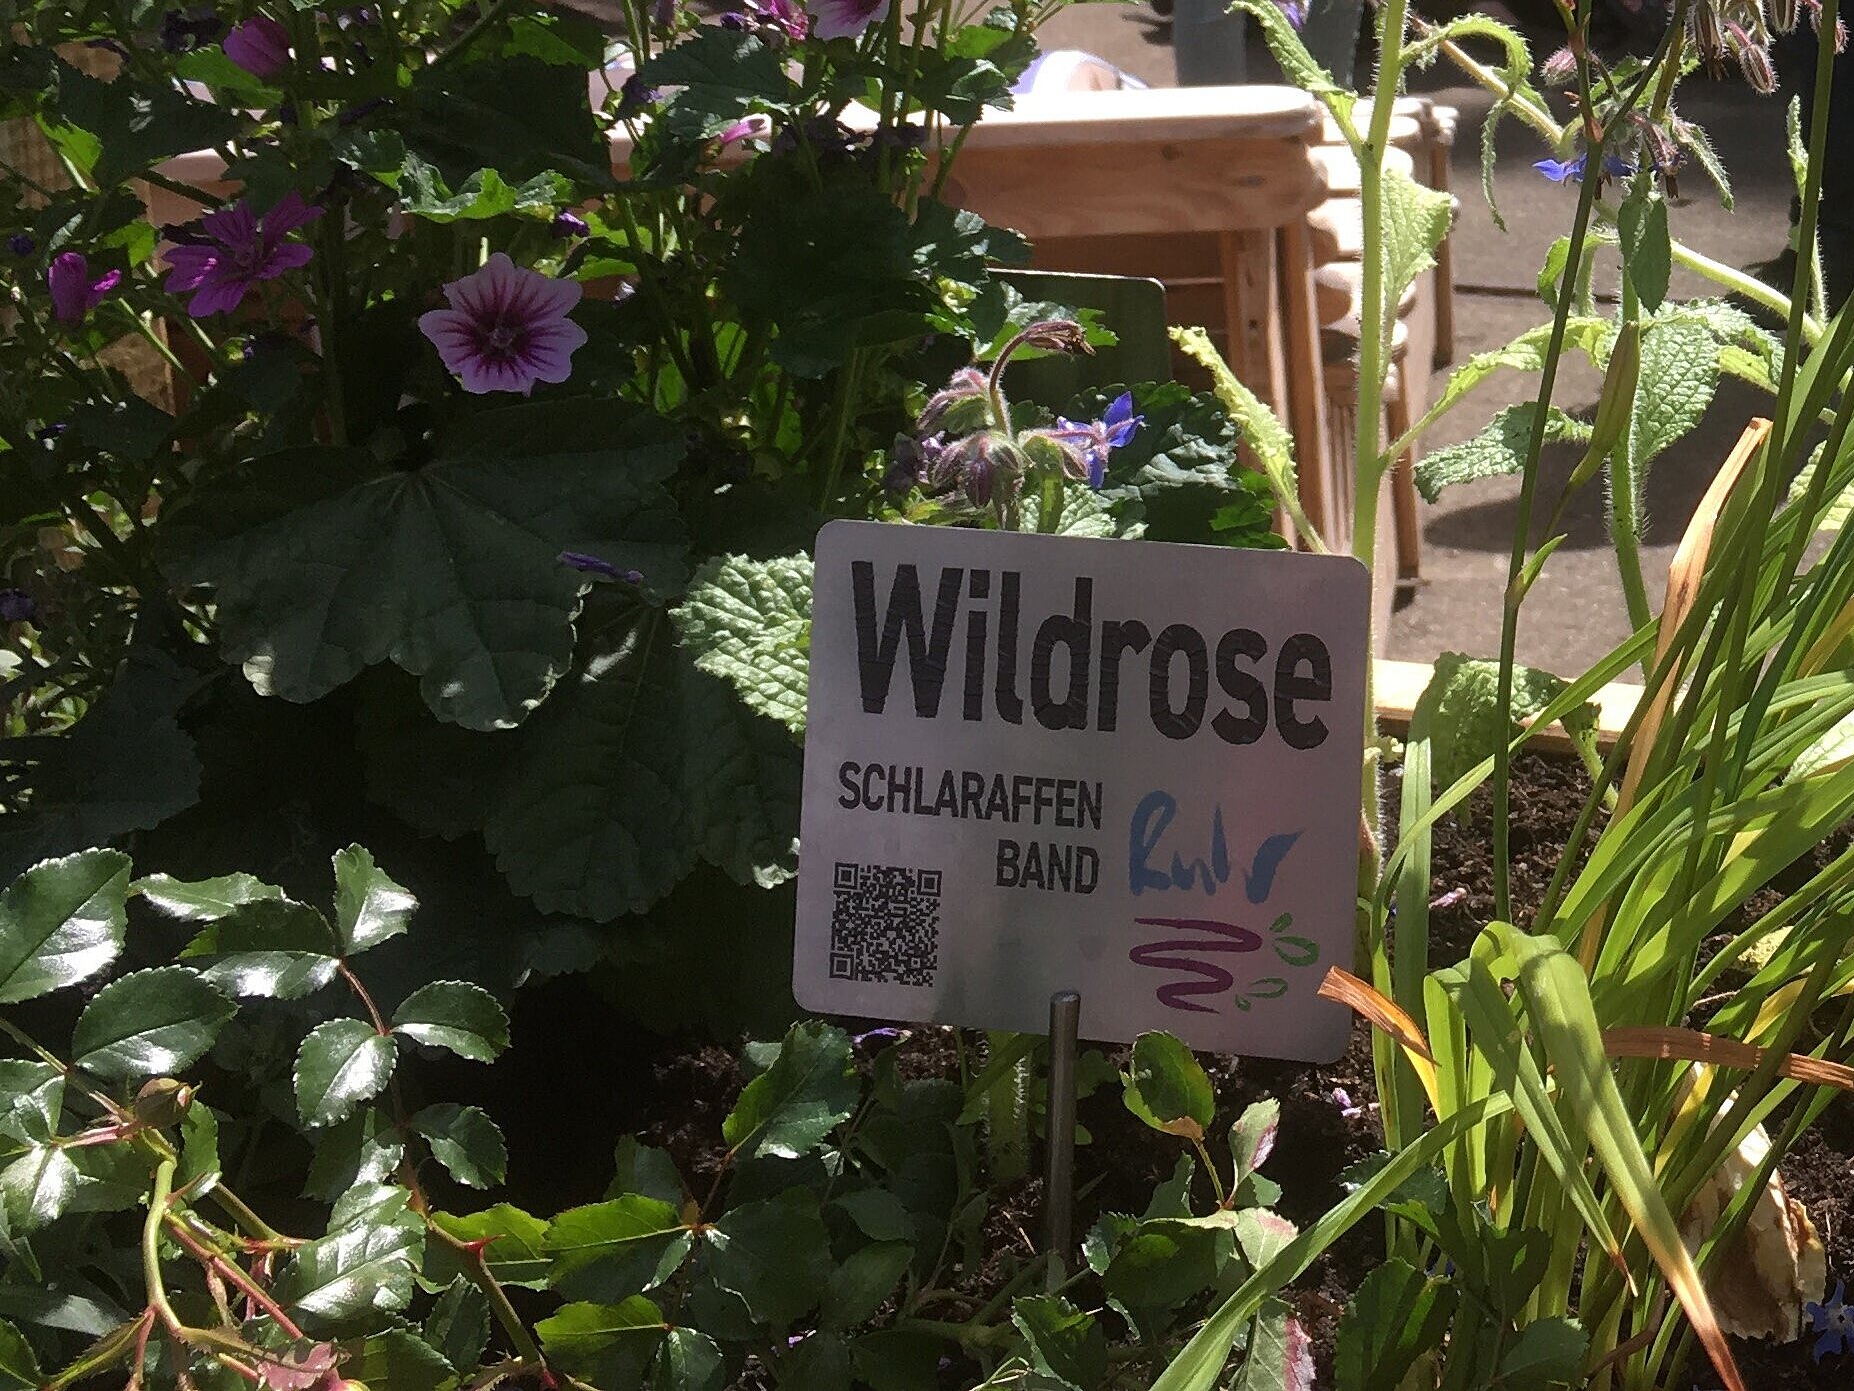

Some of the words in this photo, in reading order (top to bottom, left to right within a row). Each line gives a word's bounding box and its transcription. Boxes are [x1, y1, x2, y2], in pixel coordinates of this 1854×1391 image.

[851, 560, 1332, 750] Wildrose
[838, 761, 1102, 830] SCHLARAFFEN
[996, 840, 1100, 895] BAND
[1129, 790, 1305, 904] Ruhr
